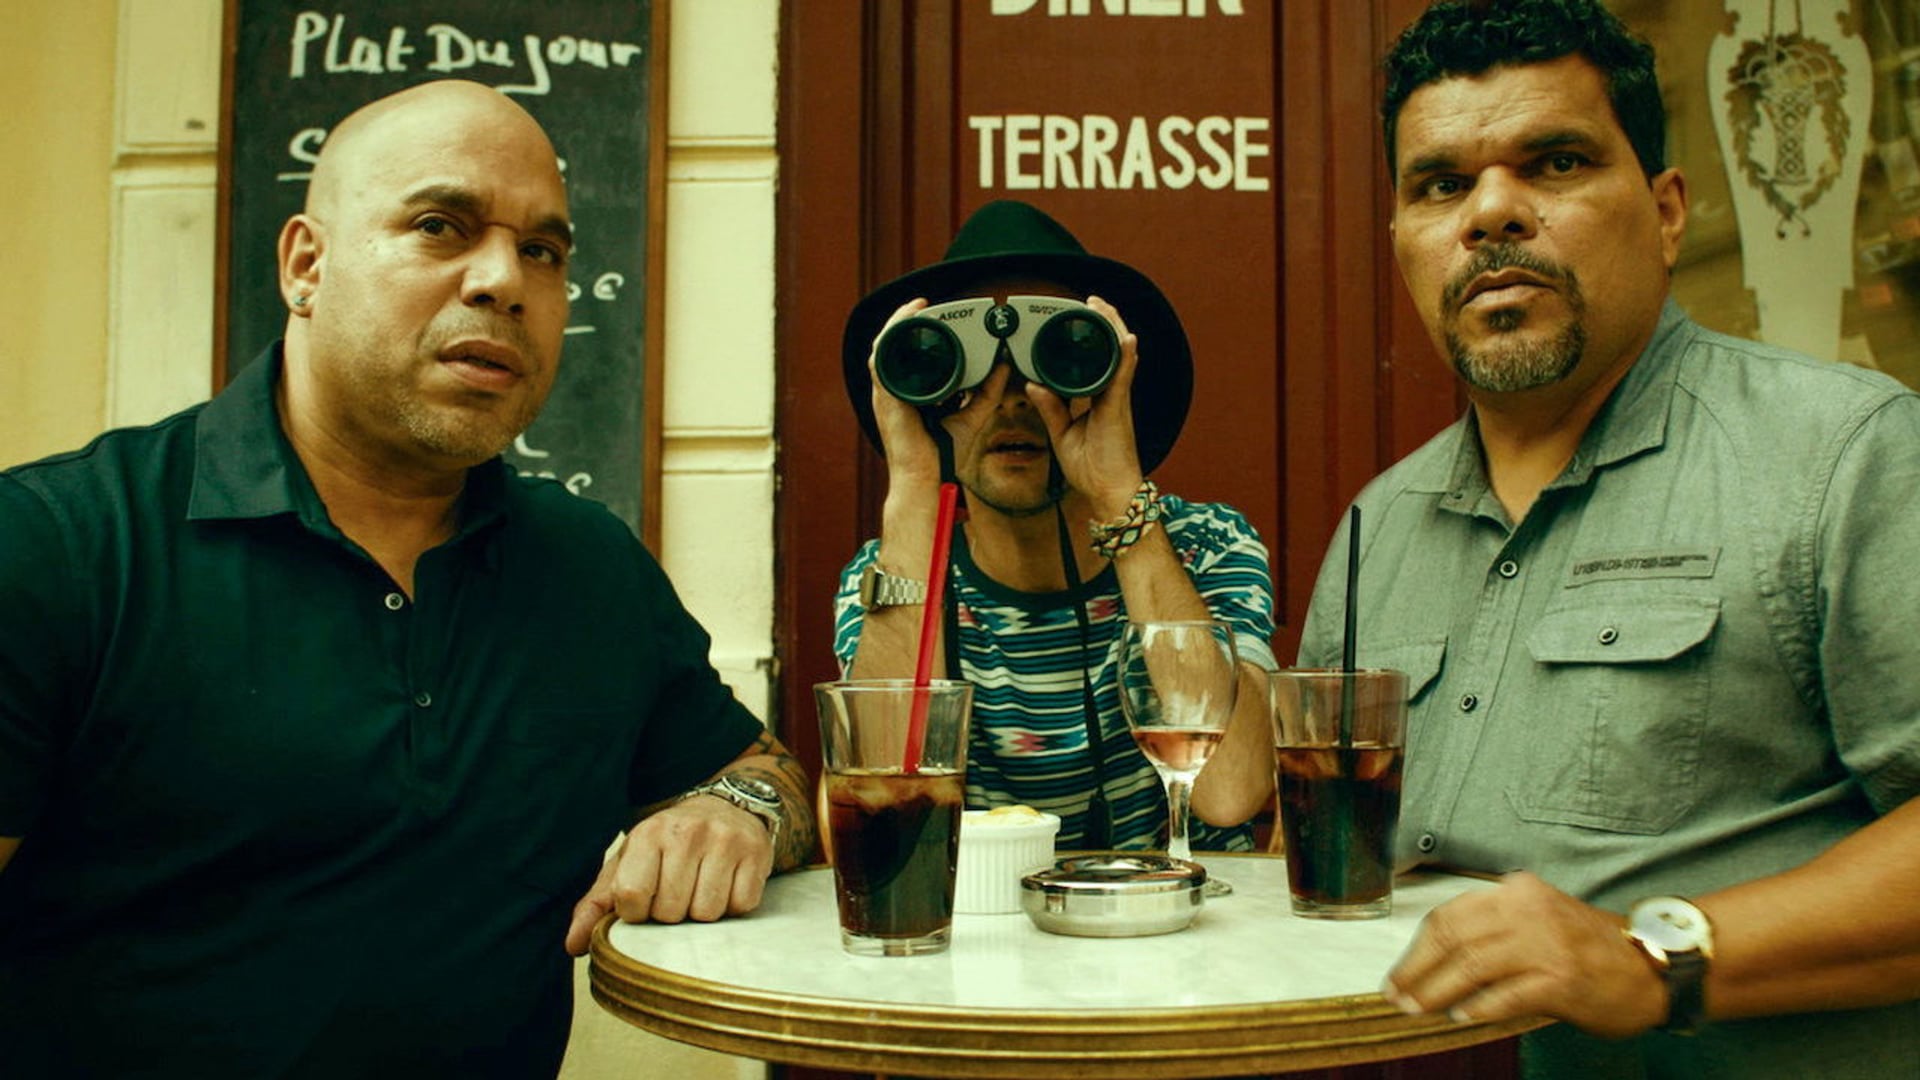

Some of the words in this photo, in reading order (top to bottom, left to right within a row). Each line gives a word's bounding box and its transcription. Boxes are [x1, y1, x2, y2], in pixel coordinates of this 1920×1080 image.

[290, 11, 415, 79] Plat
[426, 24, 514, 72] Du
[968, 114, 1270, 191] TERRASSE
[938, 308, 975, 321] ASCOT
